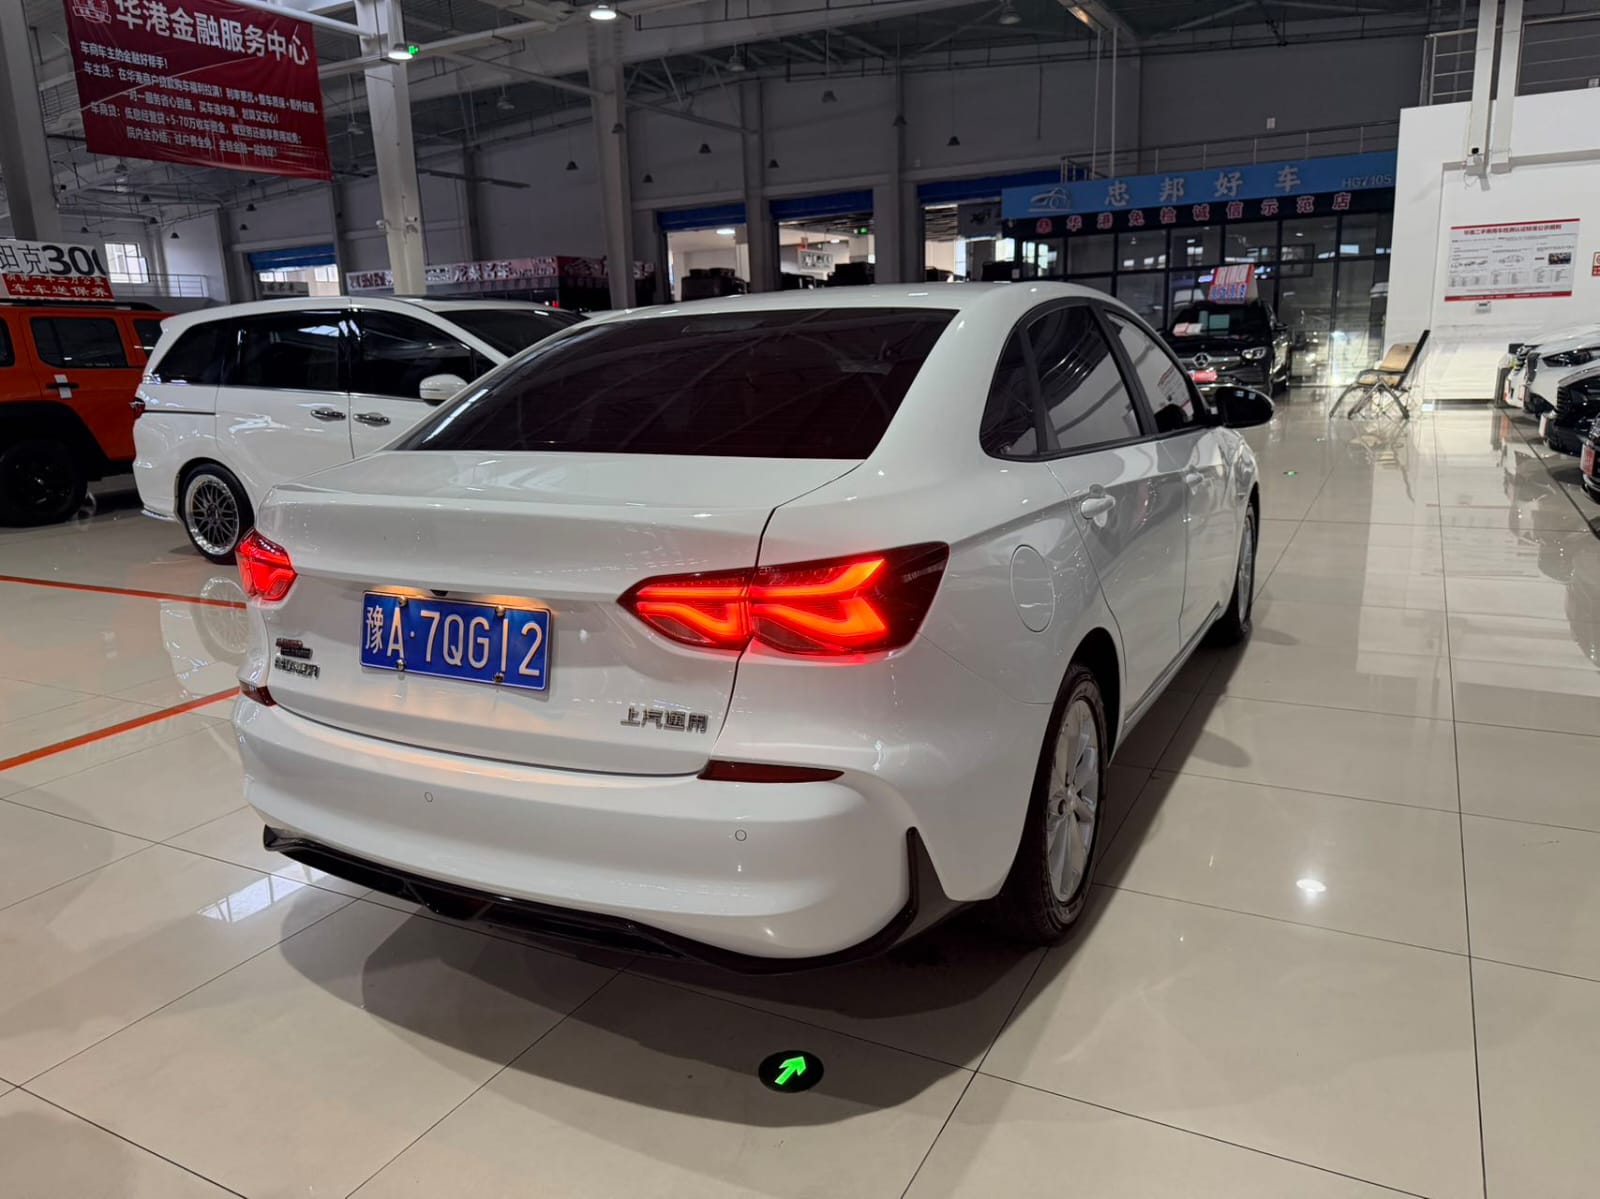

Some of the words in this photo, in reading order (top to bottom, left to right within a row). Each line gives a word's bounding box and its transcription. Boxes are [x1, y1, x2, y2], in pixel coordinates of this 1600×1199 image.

[116, 0, 310, 66] 华港金融服务中心
[1104, 166, 1302, 207] 忠邦好车
[1066, 192, 1352, 232] 华港免检诚信示范店
[11, 283, 110, 298] 车车送保养
[365, 604, 543, 677] 豫A·7QG12
[619, 705, 709, 734] 上汽通用
